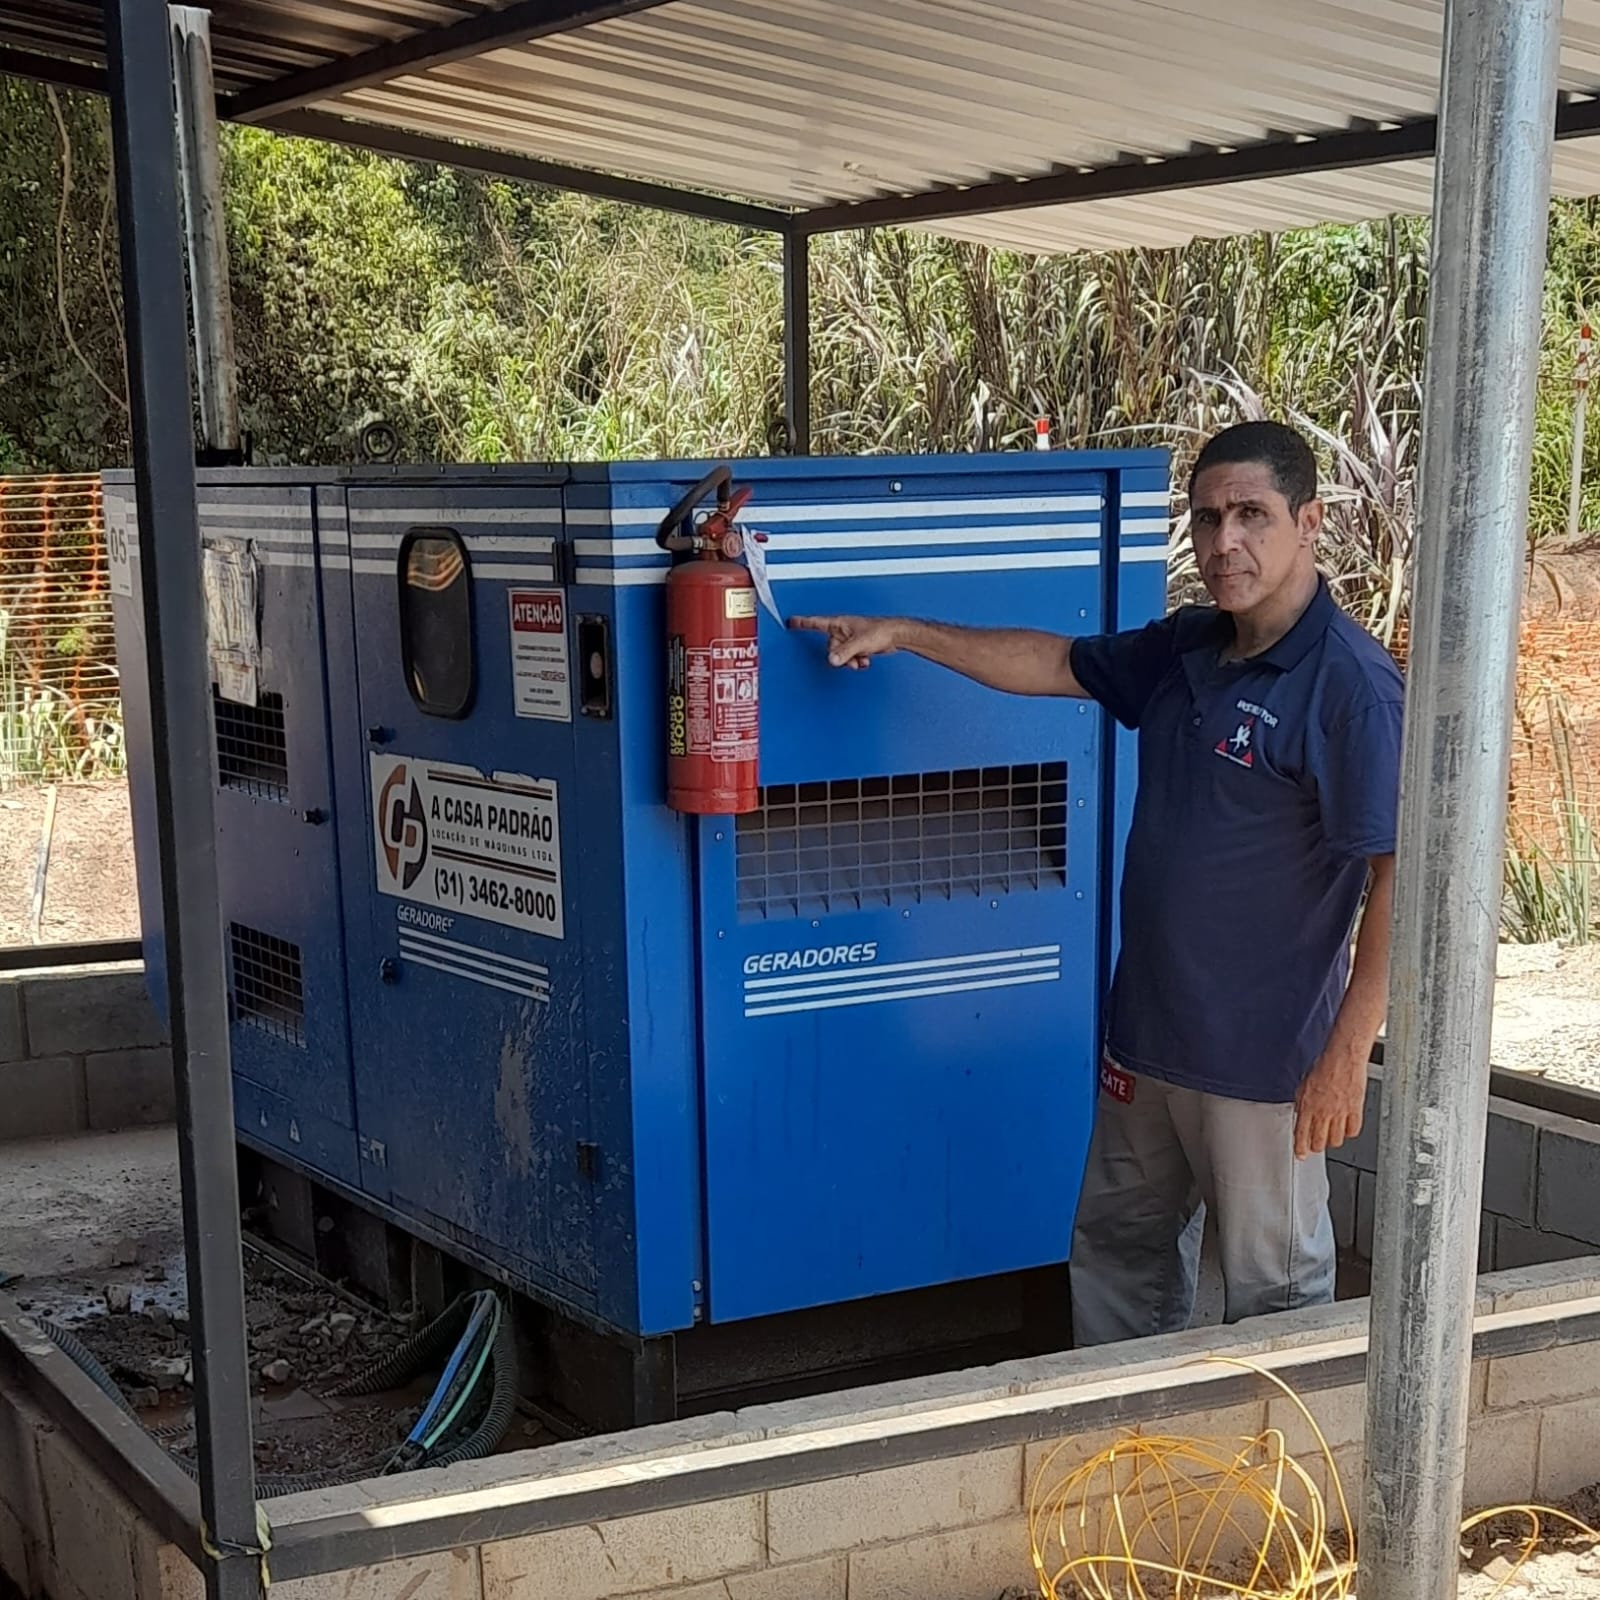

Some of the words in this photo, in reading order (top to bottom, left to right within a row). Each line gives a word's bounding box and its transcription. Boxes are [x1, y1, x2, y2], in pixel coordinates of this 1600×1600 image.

[111, 526, 127, 565] 05
[513, 600, 562, 628] ATENÇÃO
[431, 794, 441, 821] A
[444, 797, 483, 830] CASA
[488, 805, 553, 843] PADRÃO
[469, 836, 480, 848] DE
[435, 866, 465, 906] (31)
[469, 875, 557, 922] 3462-8000
[743, 942, 878, 975] GERADORES
